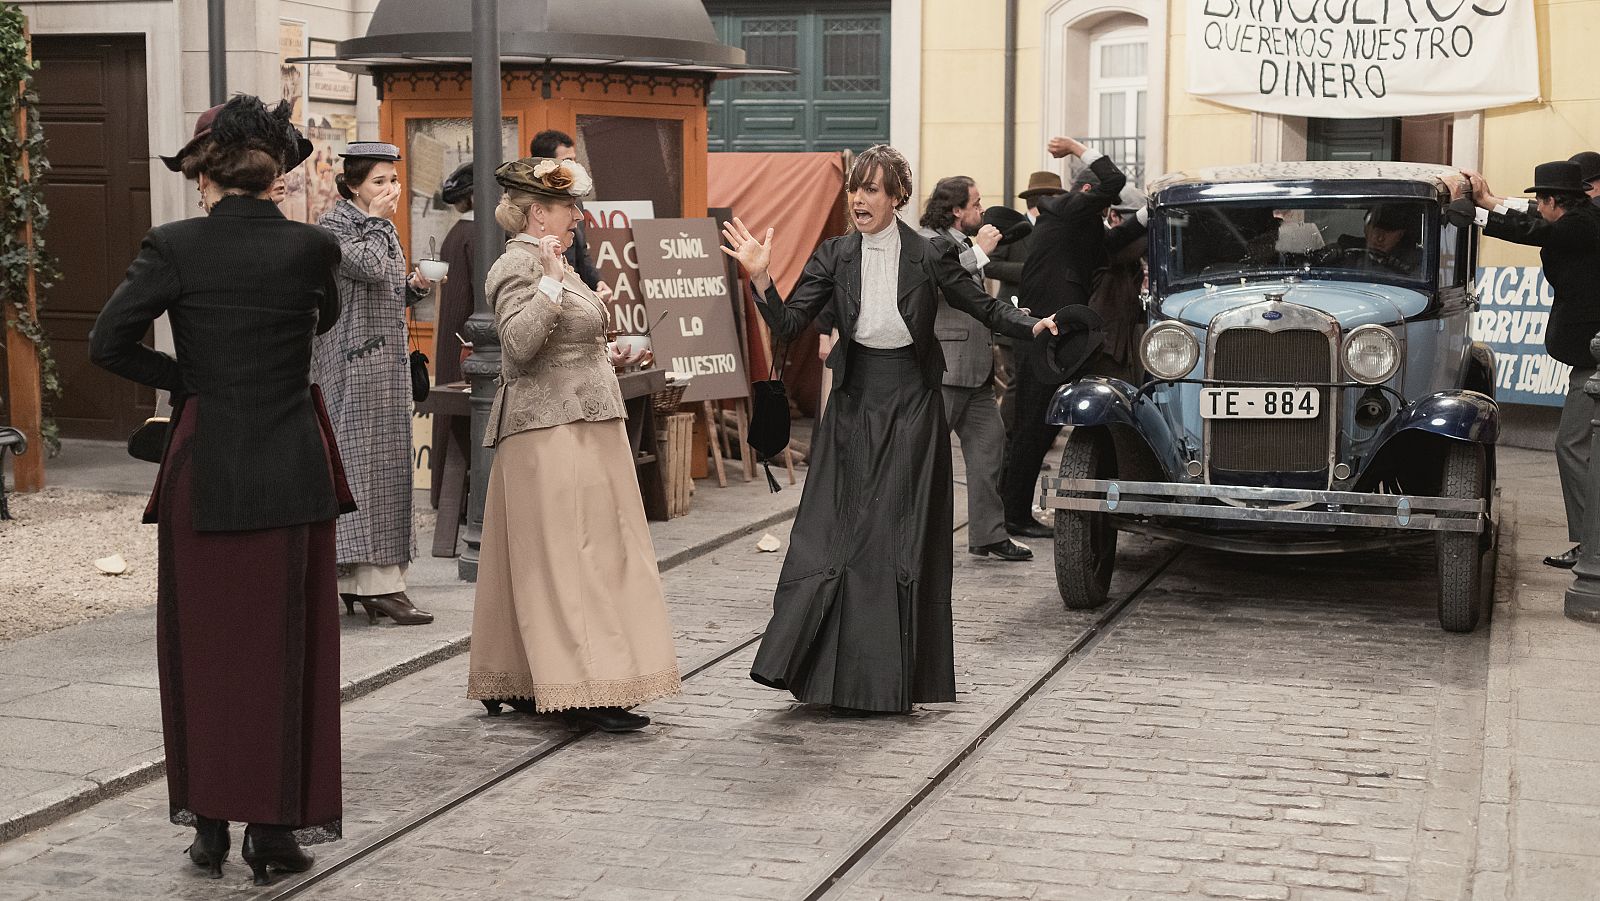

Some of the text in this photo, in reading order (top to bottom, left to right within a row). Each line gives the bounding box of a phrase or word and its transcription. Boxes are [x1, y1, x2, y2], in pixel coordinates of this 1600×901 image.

[1204, 21, 1474, 61] QUEREMOS NUESTRO
[1259, 59, 1387, 99] DINERO
[678, 316, 704, 337] LO
[671, 353, 736, 376] NUESTRO
